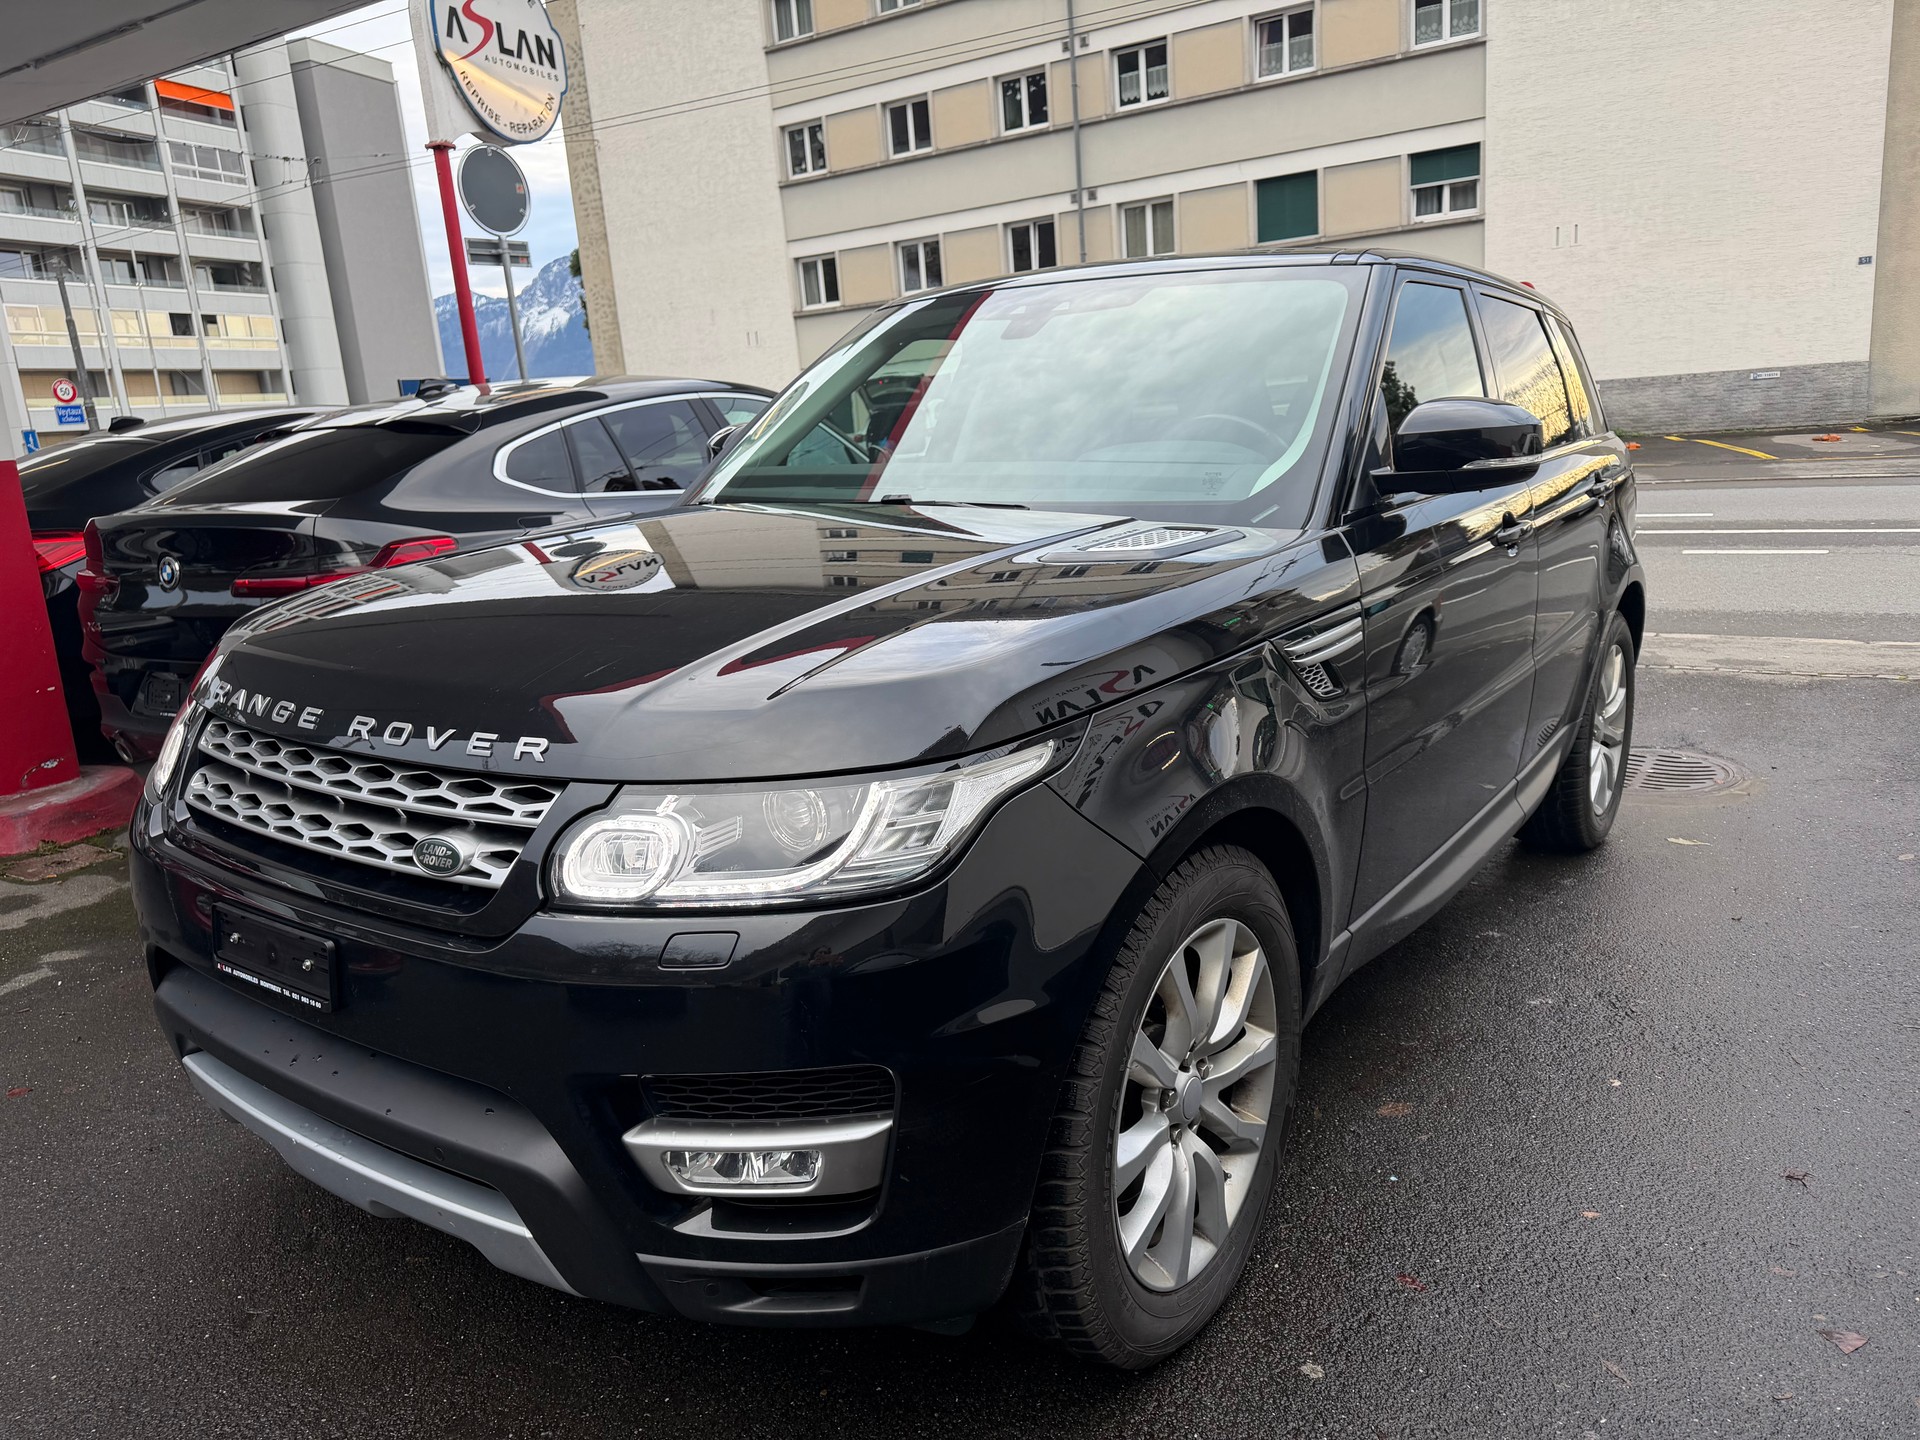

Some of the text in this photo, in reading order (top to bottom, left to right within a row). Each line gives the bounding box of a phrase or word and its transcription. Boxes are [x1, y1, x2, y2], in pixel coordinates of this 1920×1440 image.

[447, 0, 556, 69] ASLAN
[484, 54, 559, 82] AUTOMOBILES
[460, 70, 501, 125] REPRISE
[510, 92, 555, 134] REPARATION
[59, 387, 70, 396] 50
[57, 407, 82, 417] Veytaux
[214, 680, 550, 762] RANGE ROVER
[423, 843, 447, 856] LAND
[423, 854, 452, 868] ROVER
